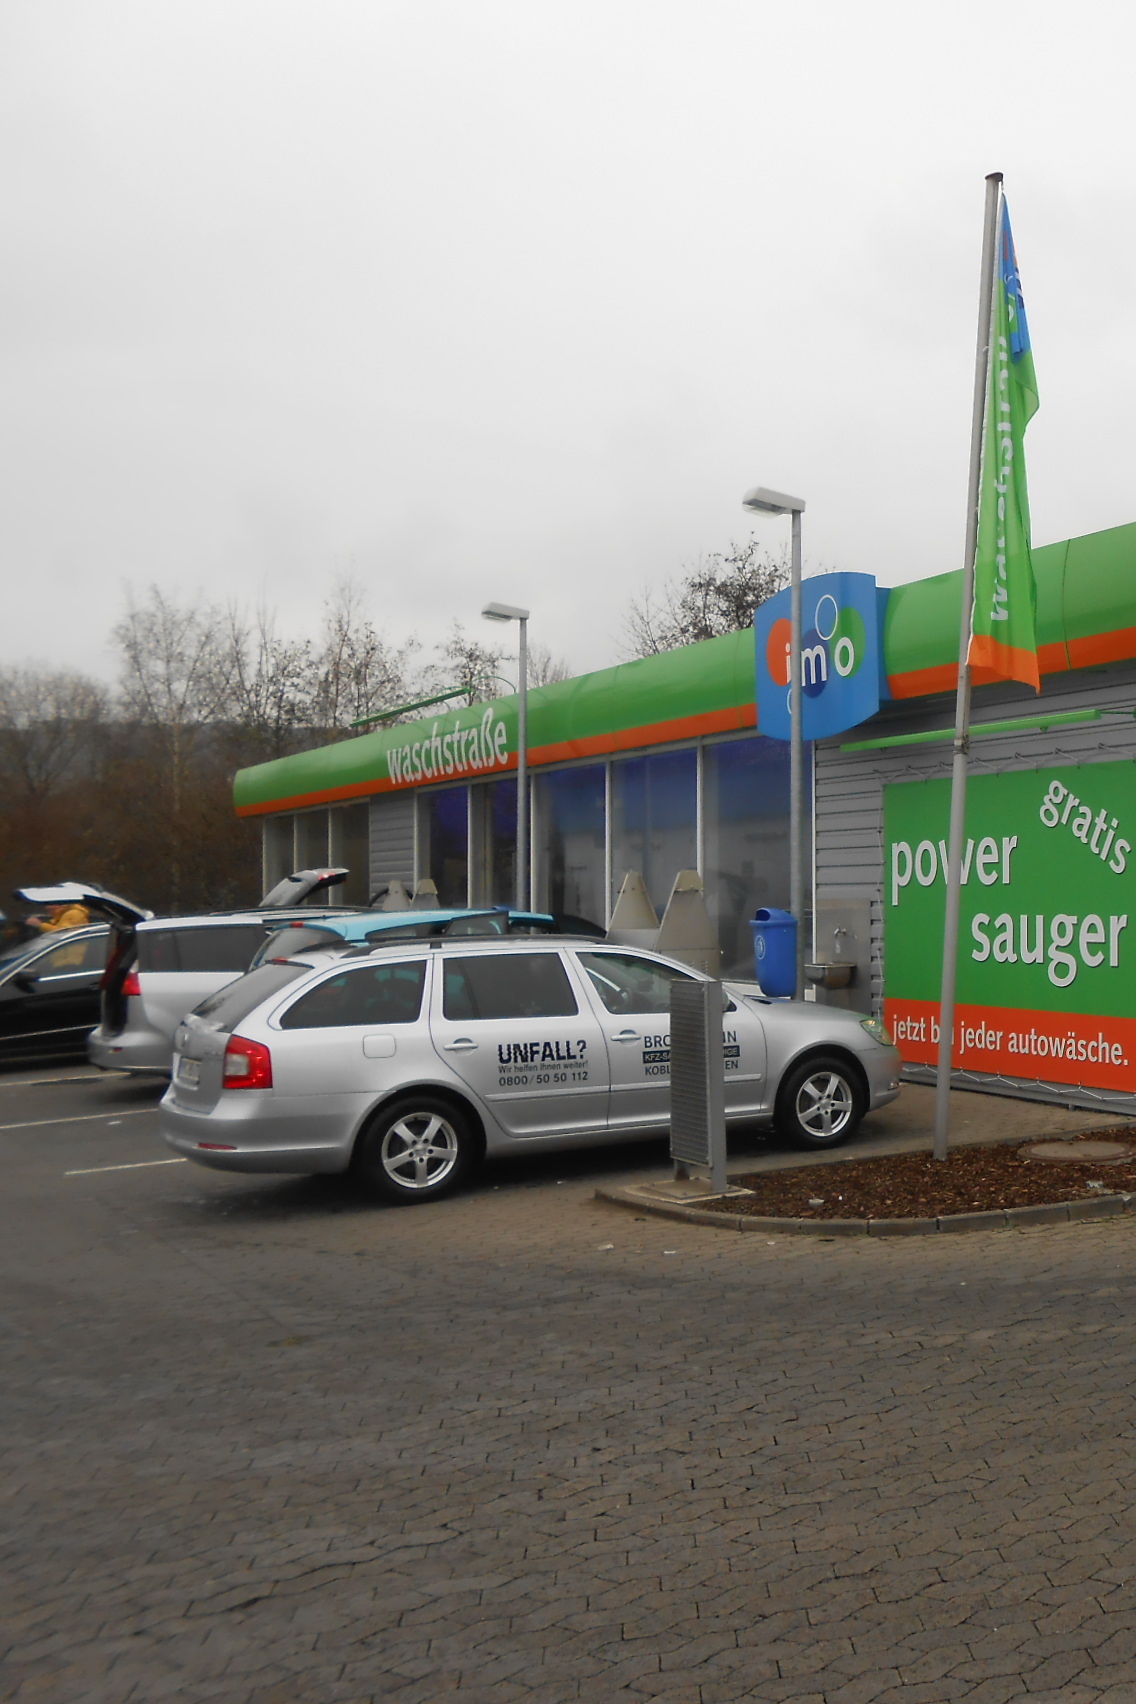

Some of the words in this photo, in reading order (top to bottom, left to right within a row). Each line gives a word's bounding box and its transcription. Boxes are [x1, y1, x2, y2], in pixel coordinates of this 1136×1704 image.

[785, 636, 855, 687] imo
[387, 707, 508, 785] waschstraße
[1039, 780, 1131, 874] gratis
[891, 835, 1018, 906] power
[971, 912, 1128, 987] sauger
[498, 1039, 587, 1065] UNFALL?
[892, 1014, 926, 1046] jetzt
[959, 1020, 1004, 1055] jeder
[1008, 1028, 1129, 1066] autowäsche.
[553, 1072, 567, 1083] 50
[572, 1071, 588, 1081] 112
